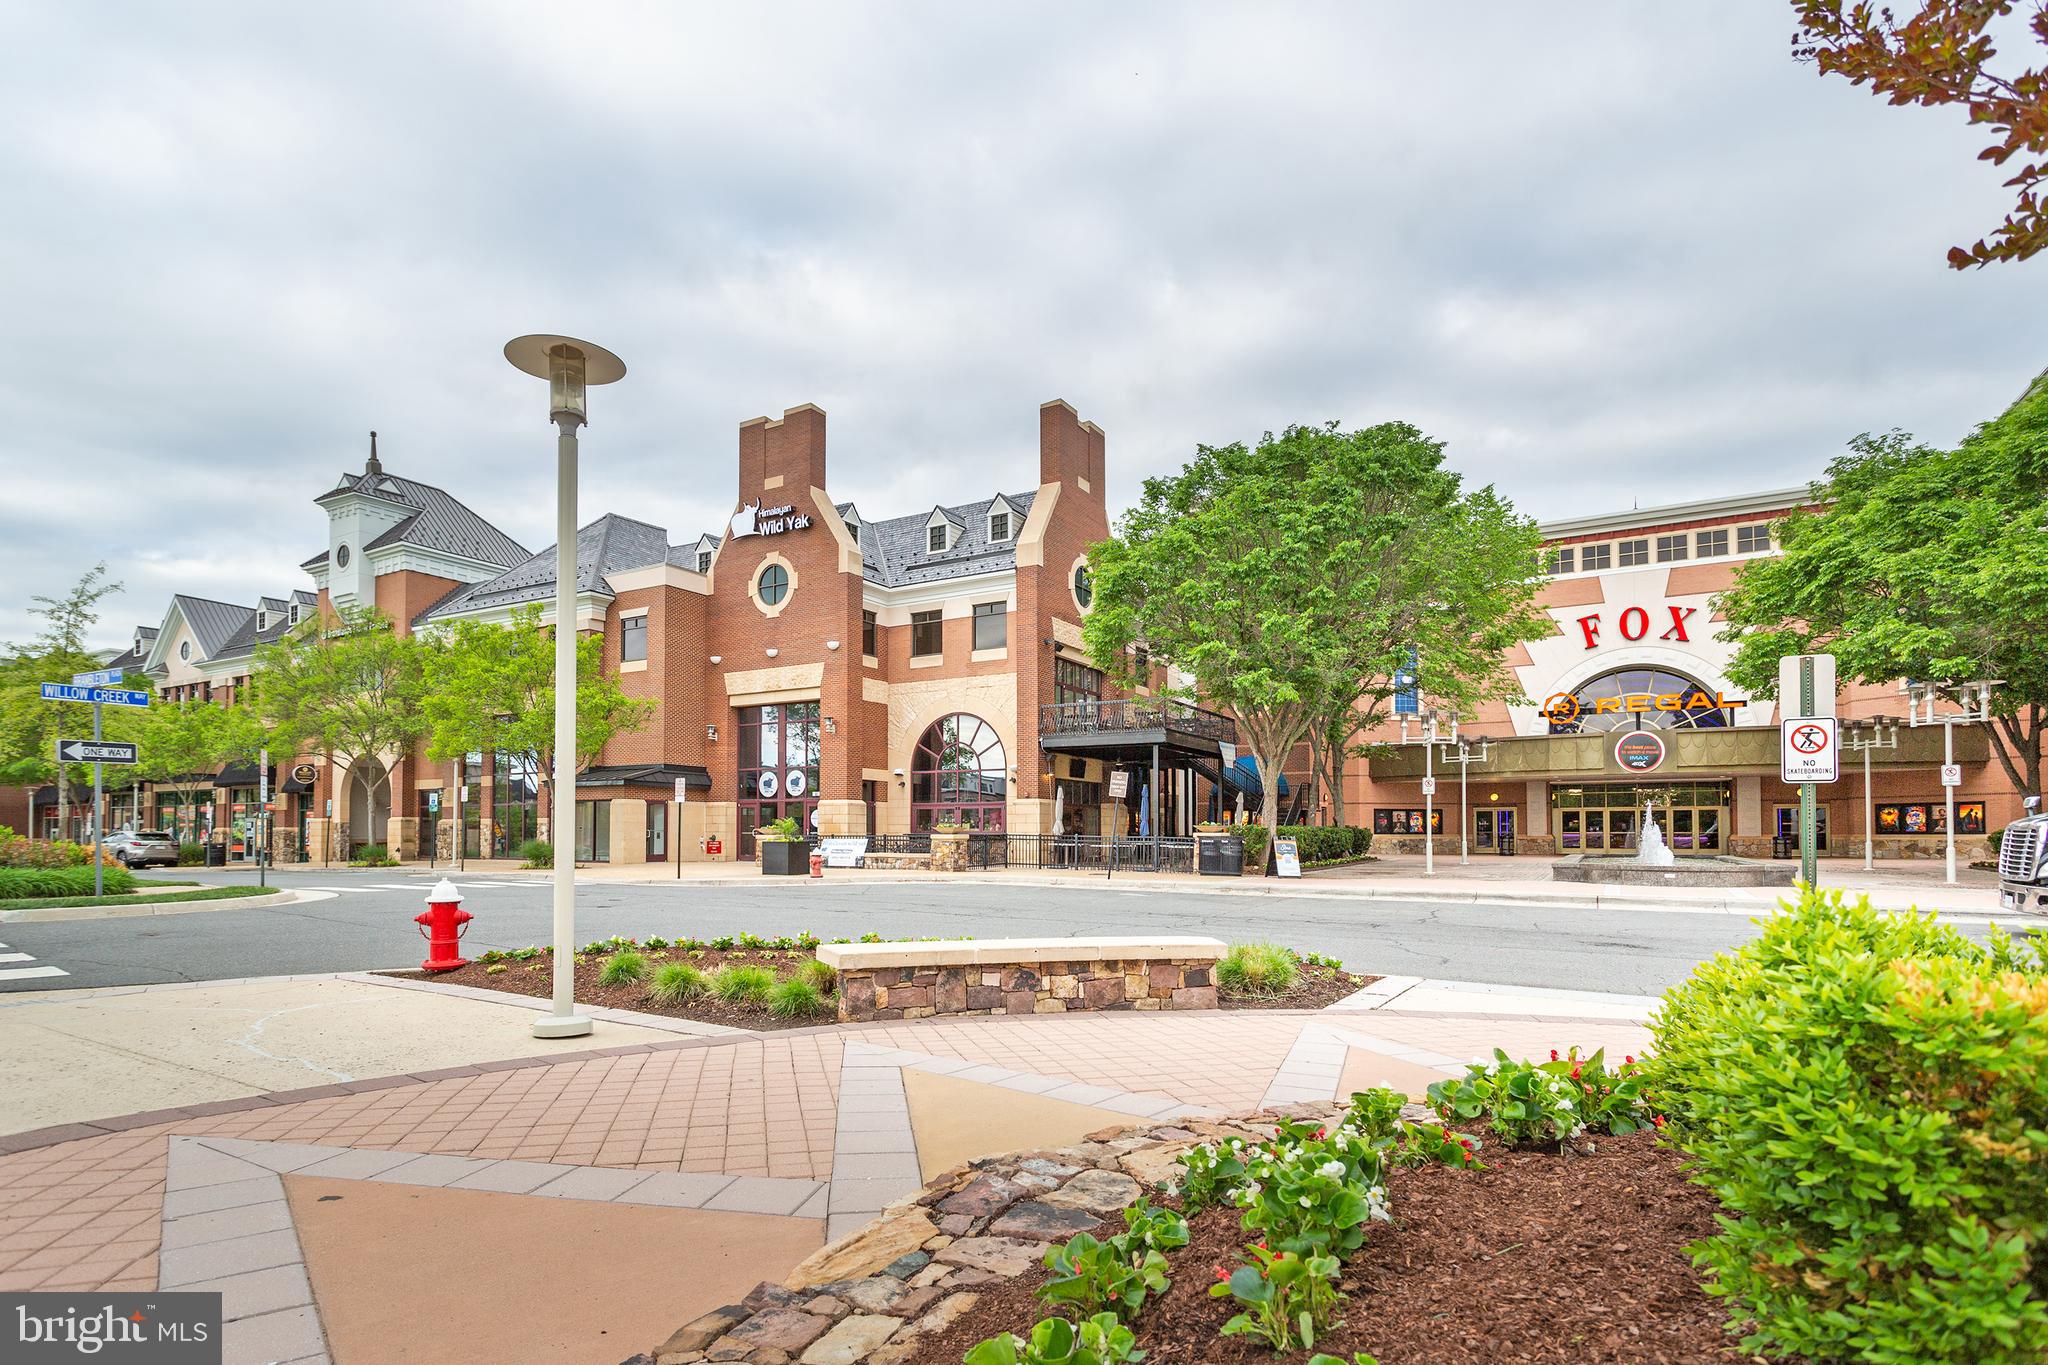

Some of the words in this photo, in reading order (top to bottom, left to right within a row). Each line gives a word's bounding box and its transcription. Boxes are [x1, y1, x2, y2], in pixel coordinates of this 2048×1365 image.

[759, 505, 792, 518] Himalayan
[759, 518, 784, 536] Wild
[786, 514, 809, 530] Yak
[1577, 606, 1697, 649] FOX
[44, 685, 89, 700] WILLOW
[93, 689, 130, 703] CREEK
[1596, 691, 1745, 713] REGAL
[83, 747, 104, 756] ONE
[108, 748, 129, 757] WAY
